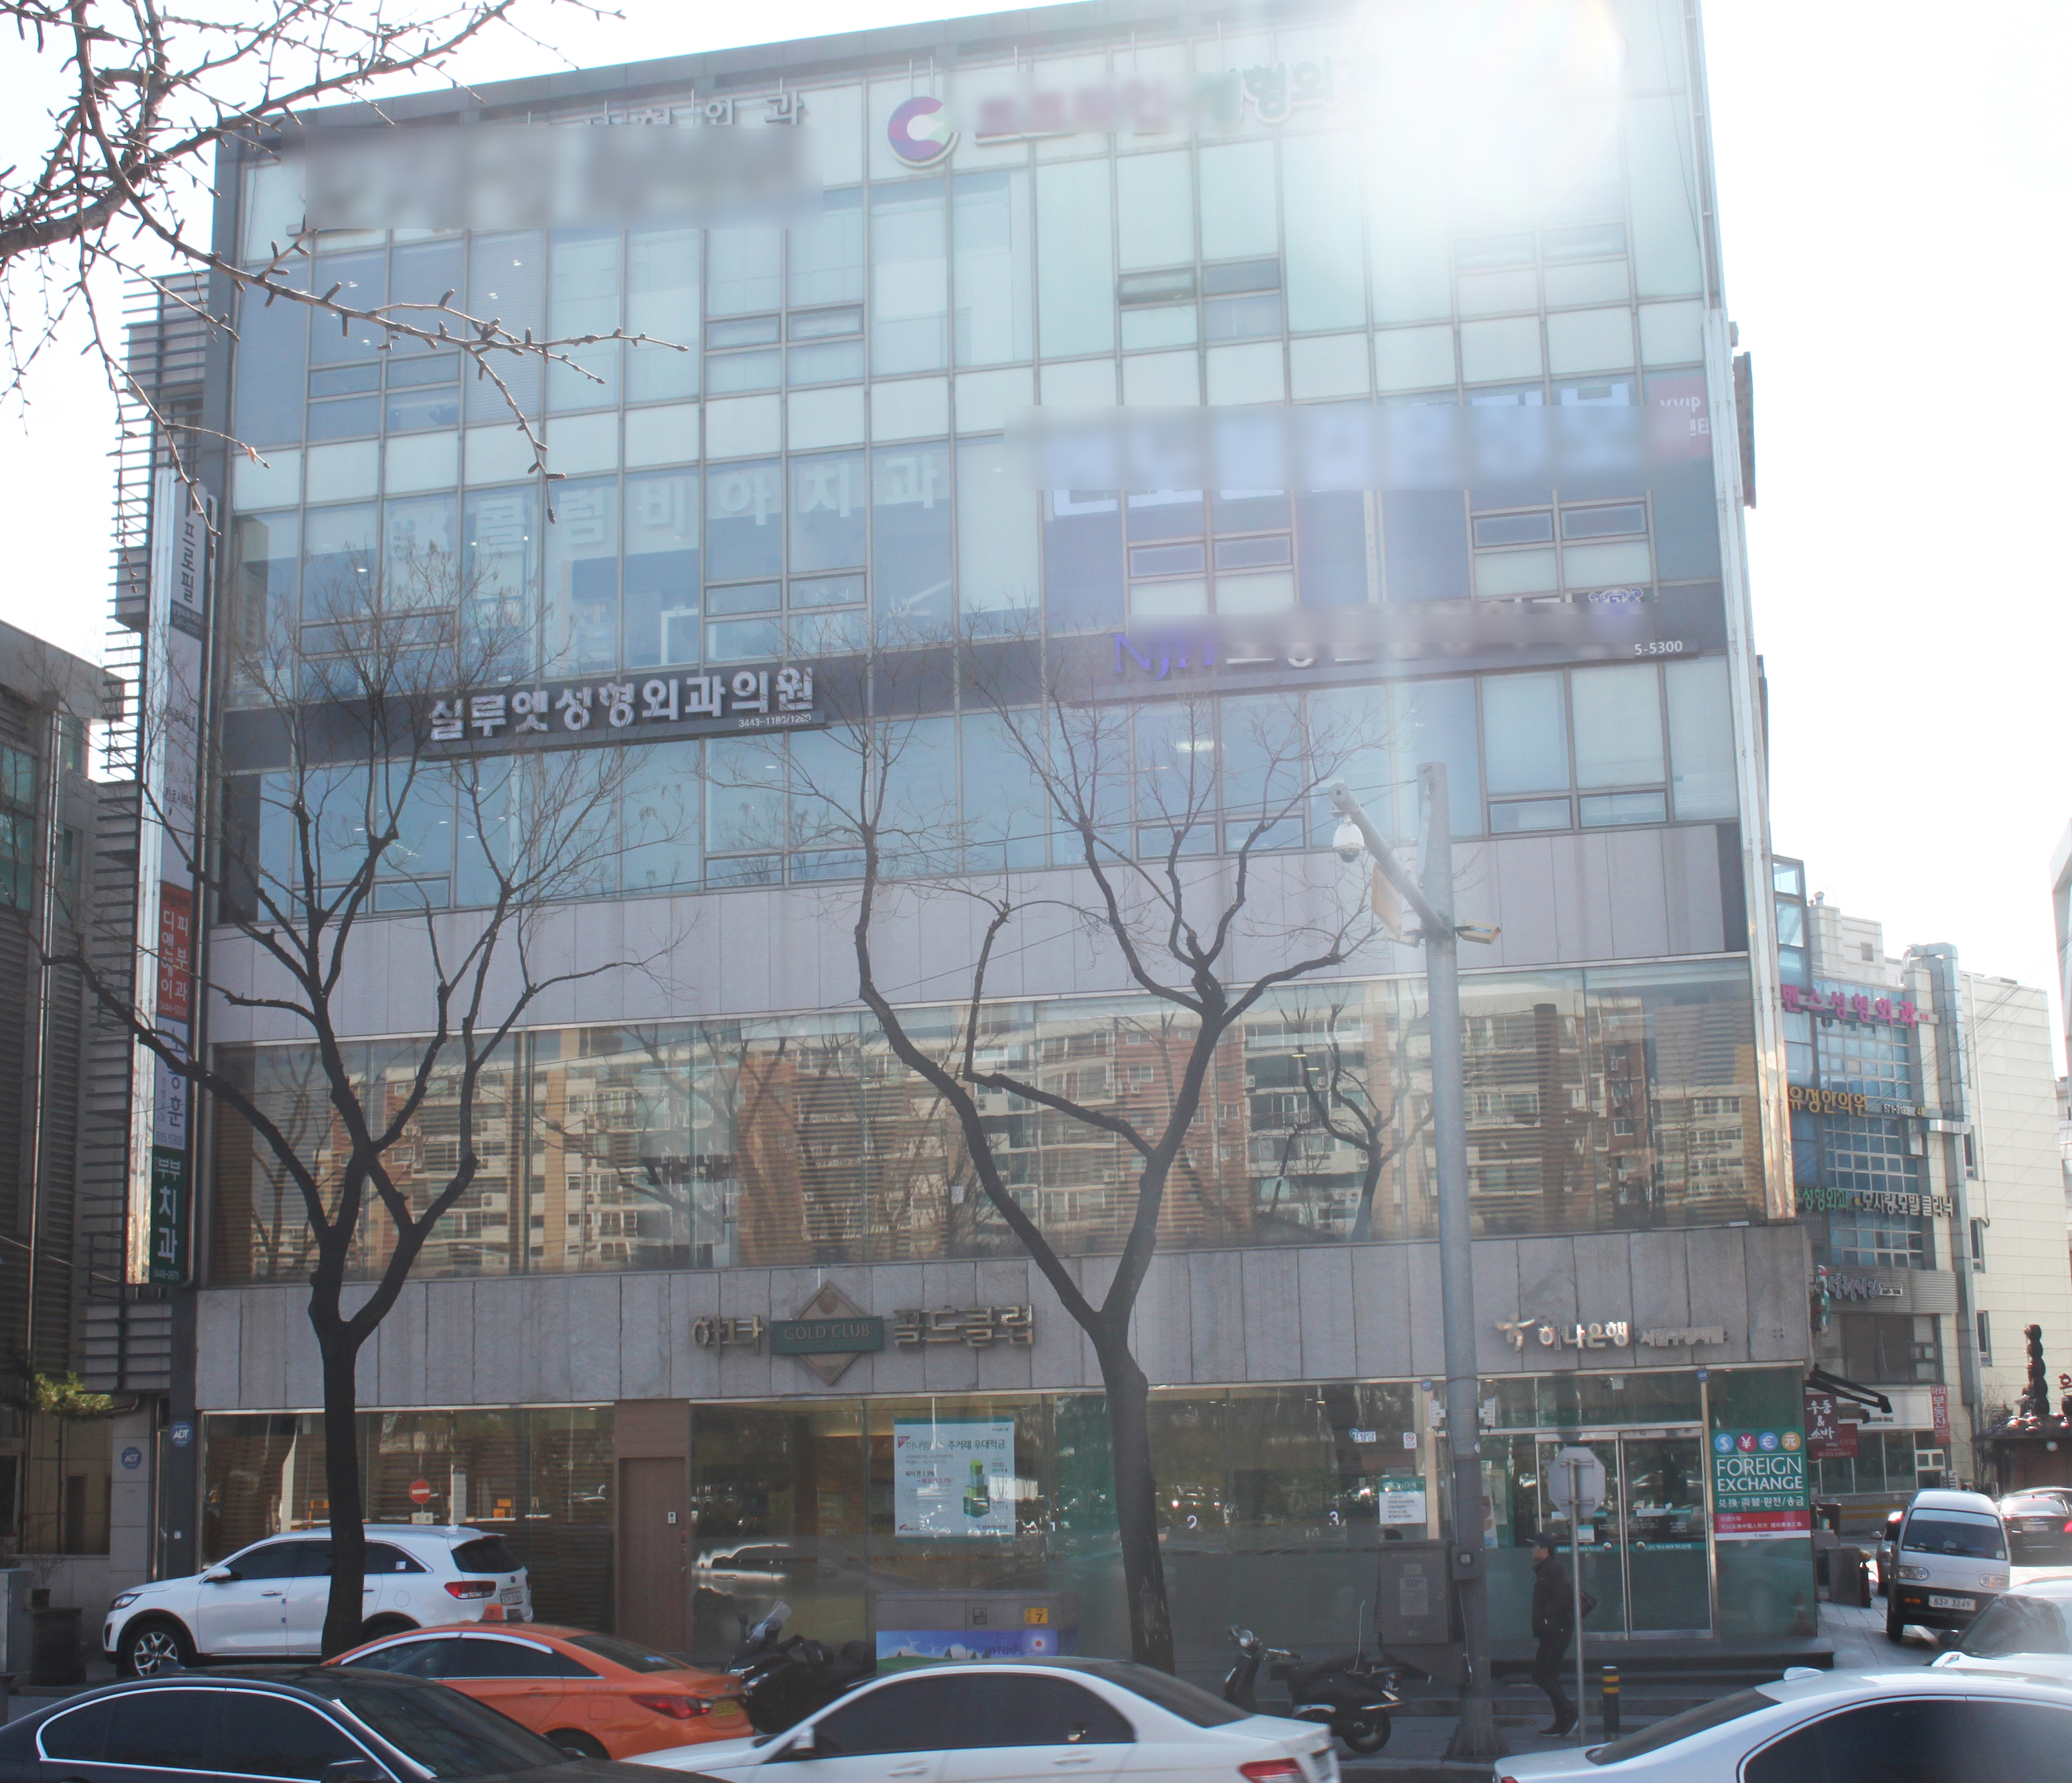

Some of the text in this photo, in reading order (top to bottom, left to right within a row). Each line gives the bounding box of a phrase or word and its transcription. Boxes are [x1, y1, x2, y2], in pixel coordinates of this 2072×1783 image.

[158, 1157, 181, 1182] 부부
[157, 1186, 178, 1264] 치과
[691, 1314, 764, 1356] 하나
[784, 1323, 871, 1340] GOLD CLUB
[1538, 1321, 1630, 1350] 하나은행
[173, 1430, 189, 1439] ADT
[125, 1454, 139, 1462] ADT
[1716, 1456, 1802, 1476] FOREIGN
[1717, 1476, 1804, 1492] EXCHANGE
[1187, 1515, 1197, 1529] 2
[1329, 1511, 1339, 1526] 3
[1035, 1613, 1043, 1623] 7
